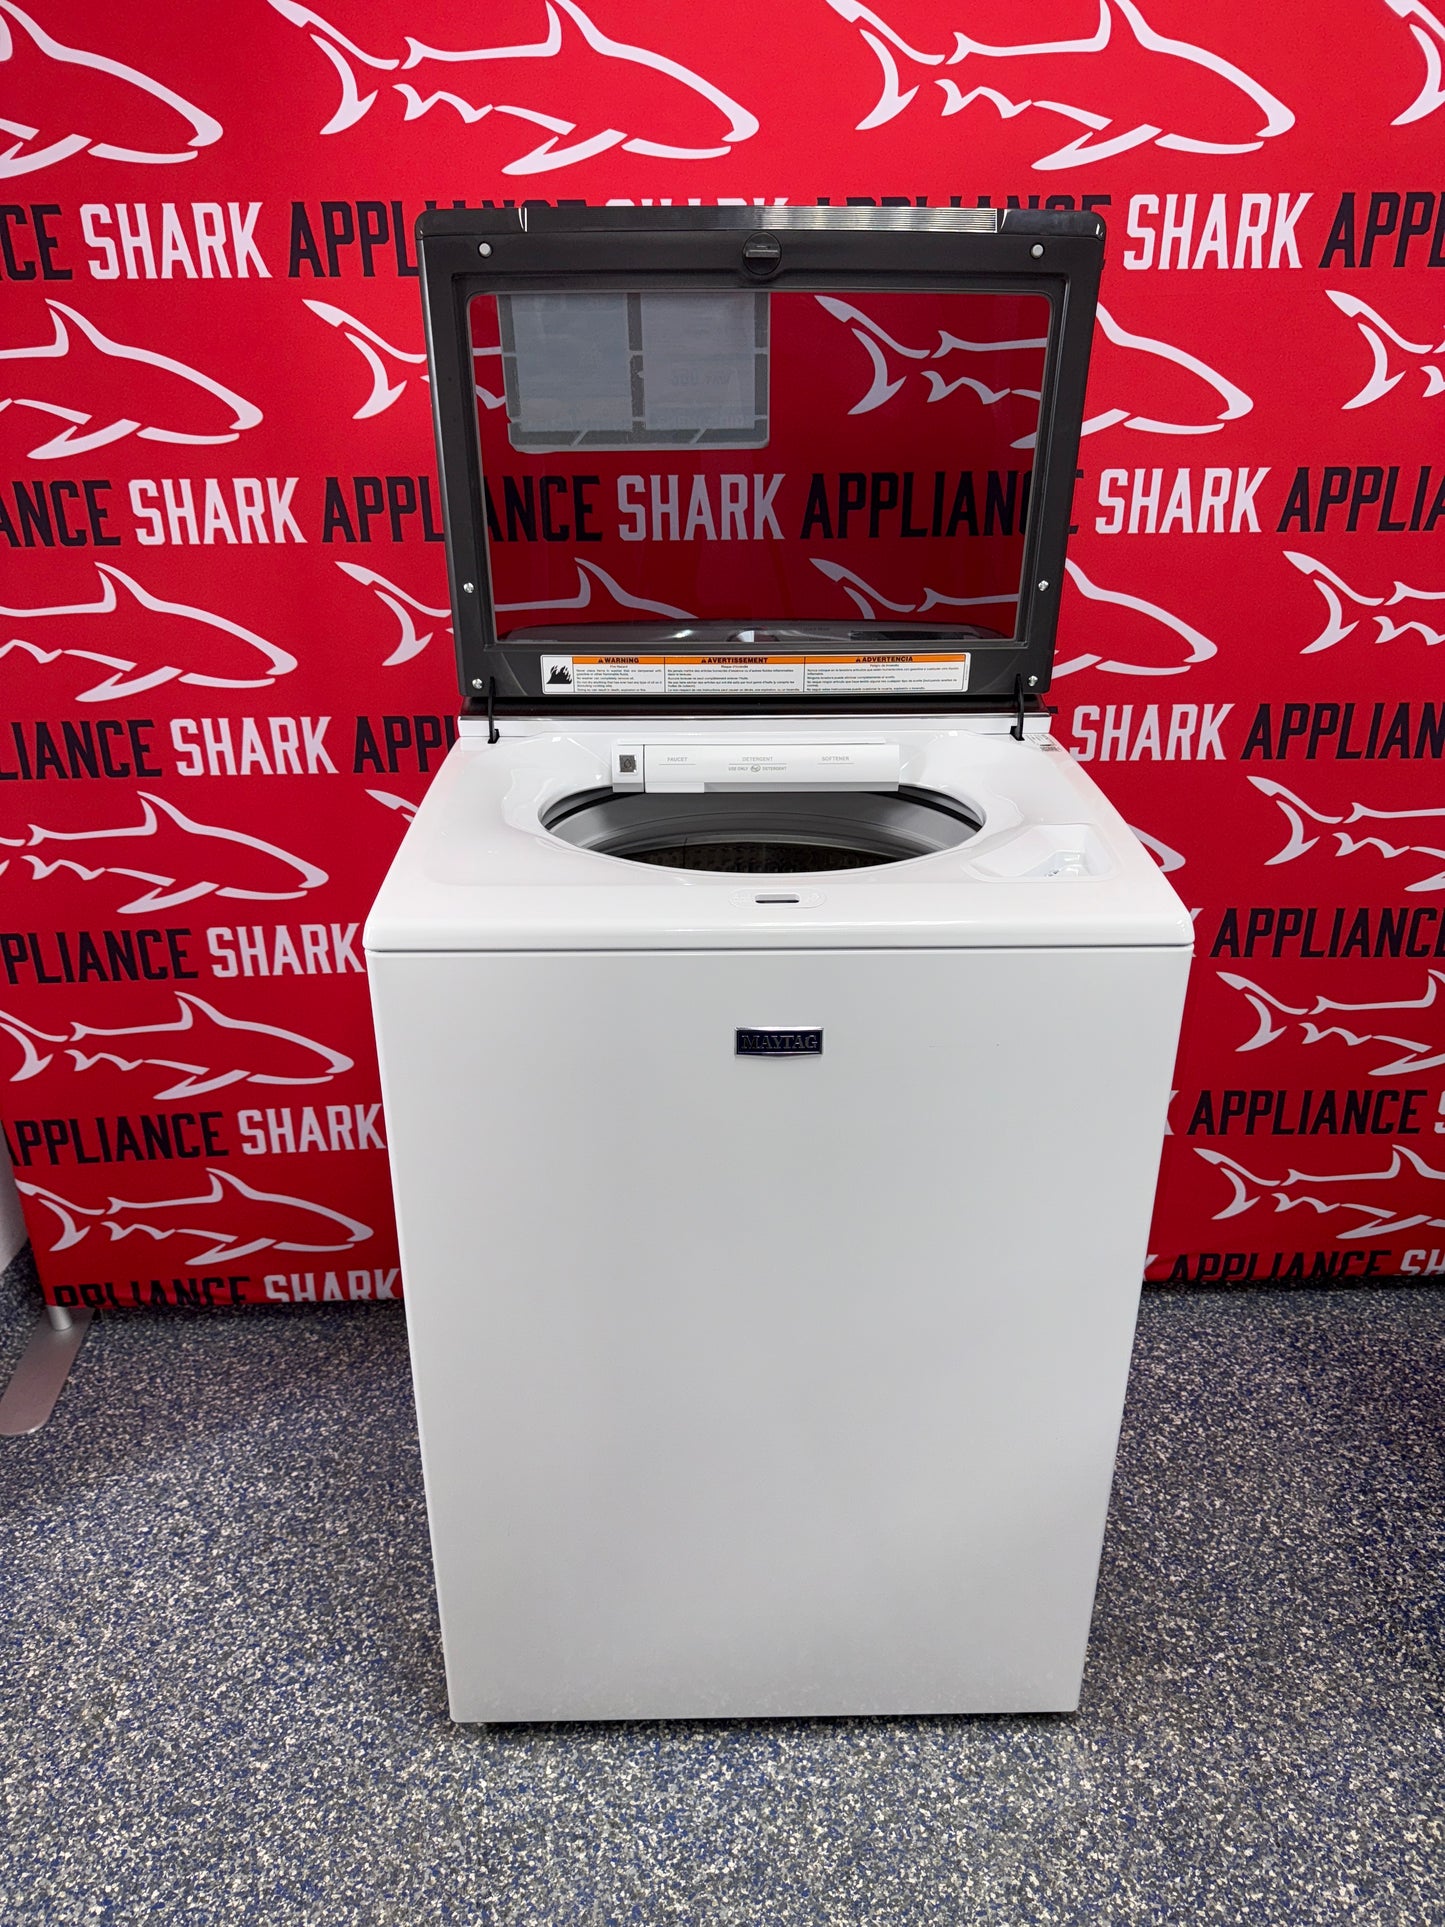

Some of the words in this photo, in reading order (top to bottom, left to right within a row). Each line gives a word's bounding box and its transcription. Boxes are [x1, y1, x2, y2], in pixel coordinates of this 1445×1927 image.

[0, 204, 73, 281] CE
[80, 202, 273, 280] SHARK
[1123, 193, 1314, 270] SHARK
[128, 477, 308, 546] SHARK
[617, 473, 786, 541] SHARK
[1095, 467, 1272, 535] SHARK
[170, 716, 340, 777] SHARK
[1069, 703, 1235, 763] SHARK
[1240, 702, 1445, 760] APPLIAN
[0, 928, 198, 985] PLIANCE
[206, 922, 367, 979] SHARK
[740, 1034, 818, 1049] MAYTAG
[237, 1103, 387, 1155] SHARK
[1186, 1089, 1428, 1136] APPLIANCE
